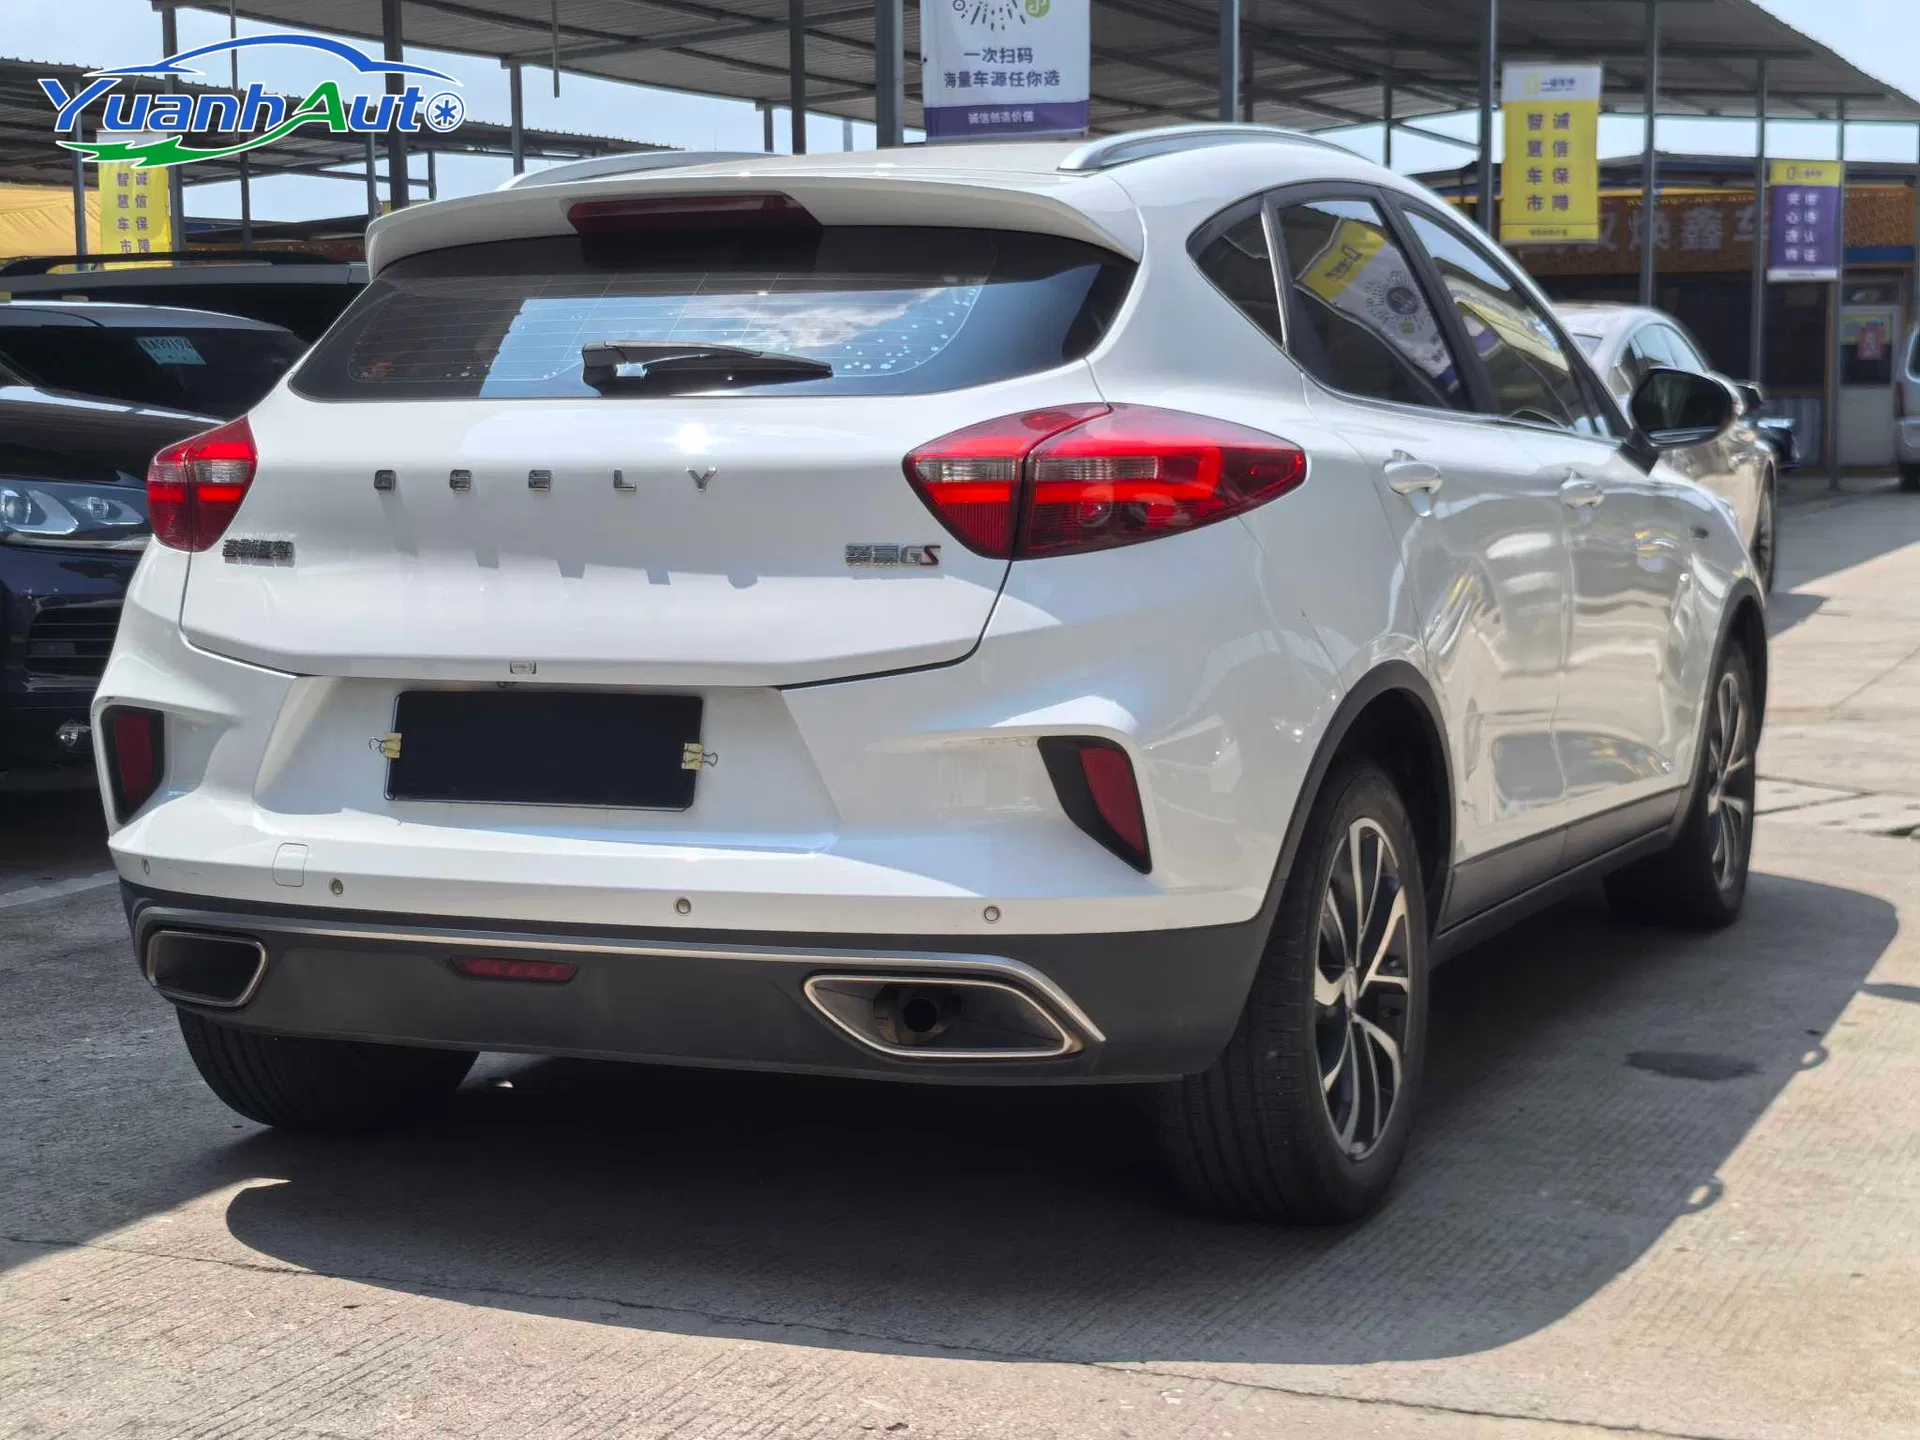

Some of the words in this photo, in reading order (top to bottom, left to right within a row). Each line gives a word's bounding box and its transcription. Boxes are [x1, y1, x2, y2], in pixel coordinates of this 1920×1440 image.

[963, 47, 1033, 63] 一次扫码
[943, 70, 1060, 88] 海量车源任你选
[373, 467, 718, 491] GEELY
